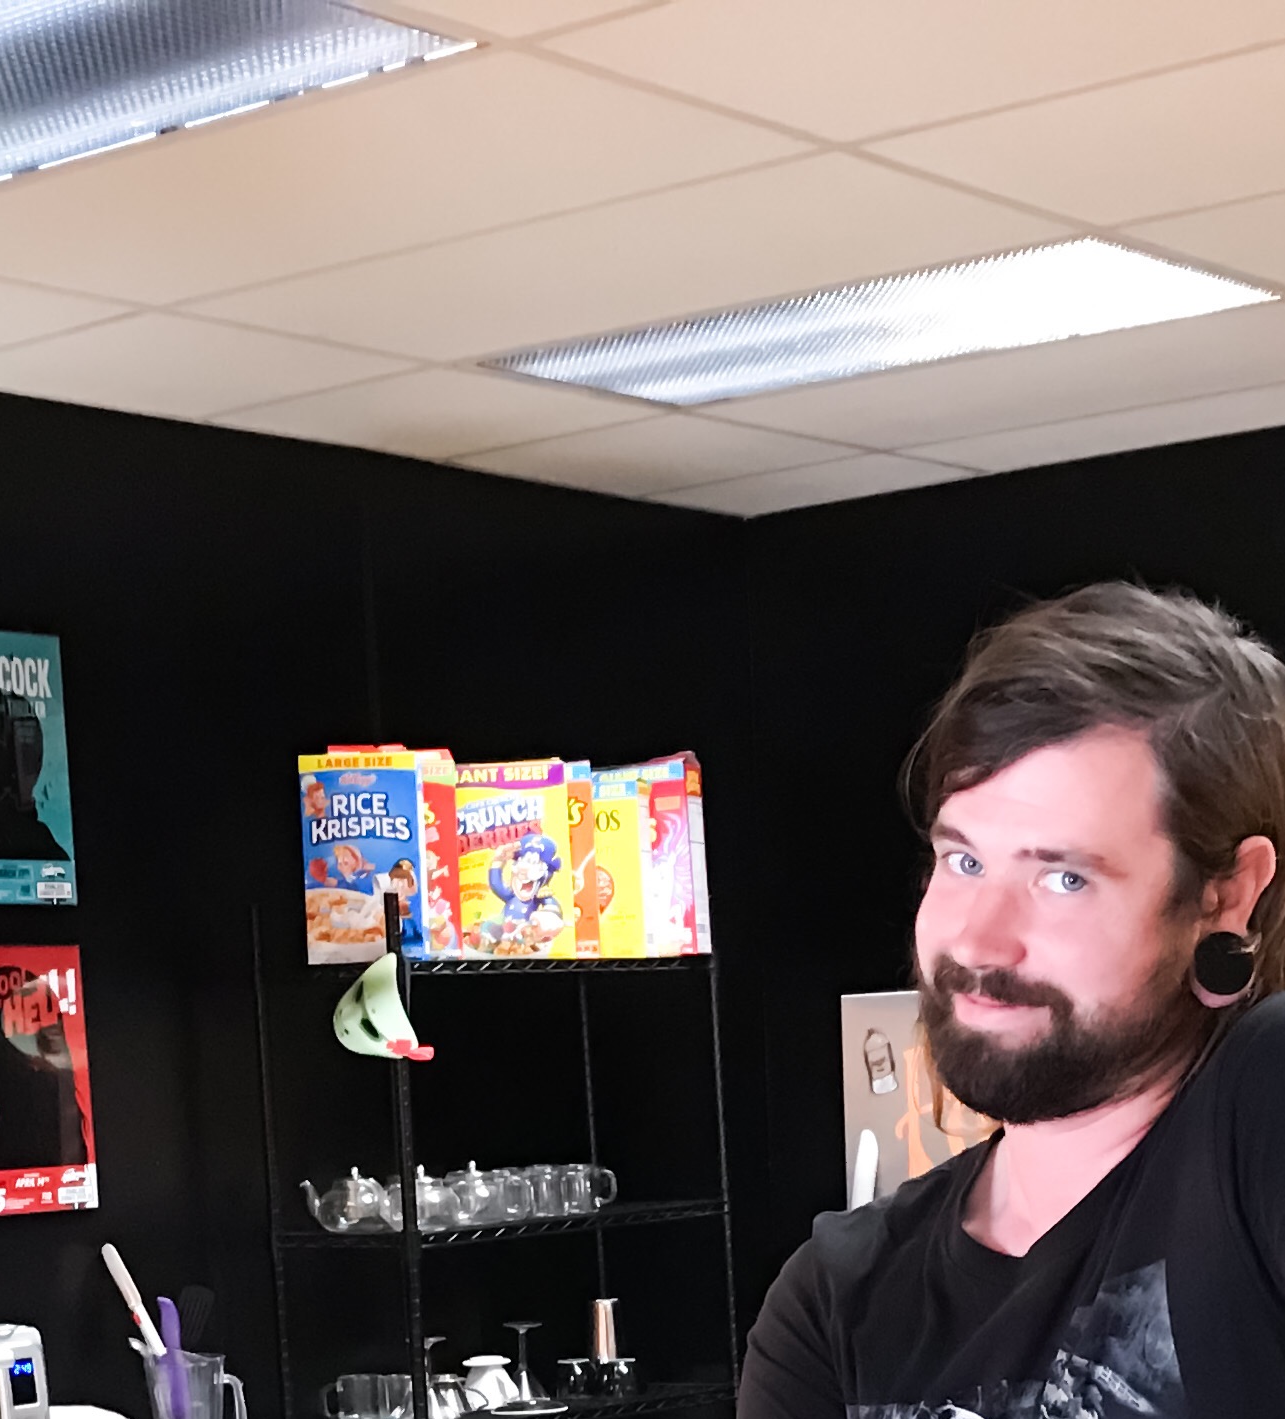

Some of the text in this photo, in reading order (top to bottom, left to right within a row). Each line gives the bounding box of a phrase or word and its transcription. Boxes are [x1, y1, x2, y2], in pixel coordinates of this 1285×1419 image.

[318, 757, 392, 768] LARGE SIZE
[504, 765, 549, 781] SIZE!
[332, 793, 387, 817] RICE
[311, 816, 410, 844] KRISPIES
